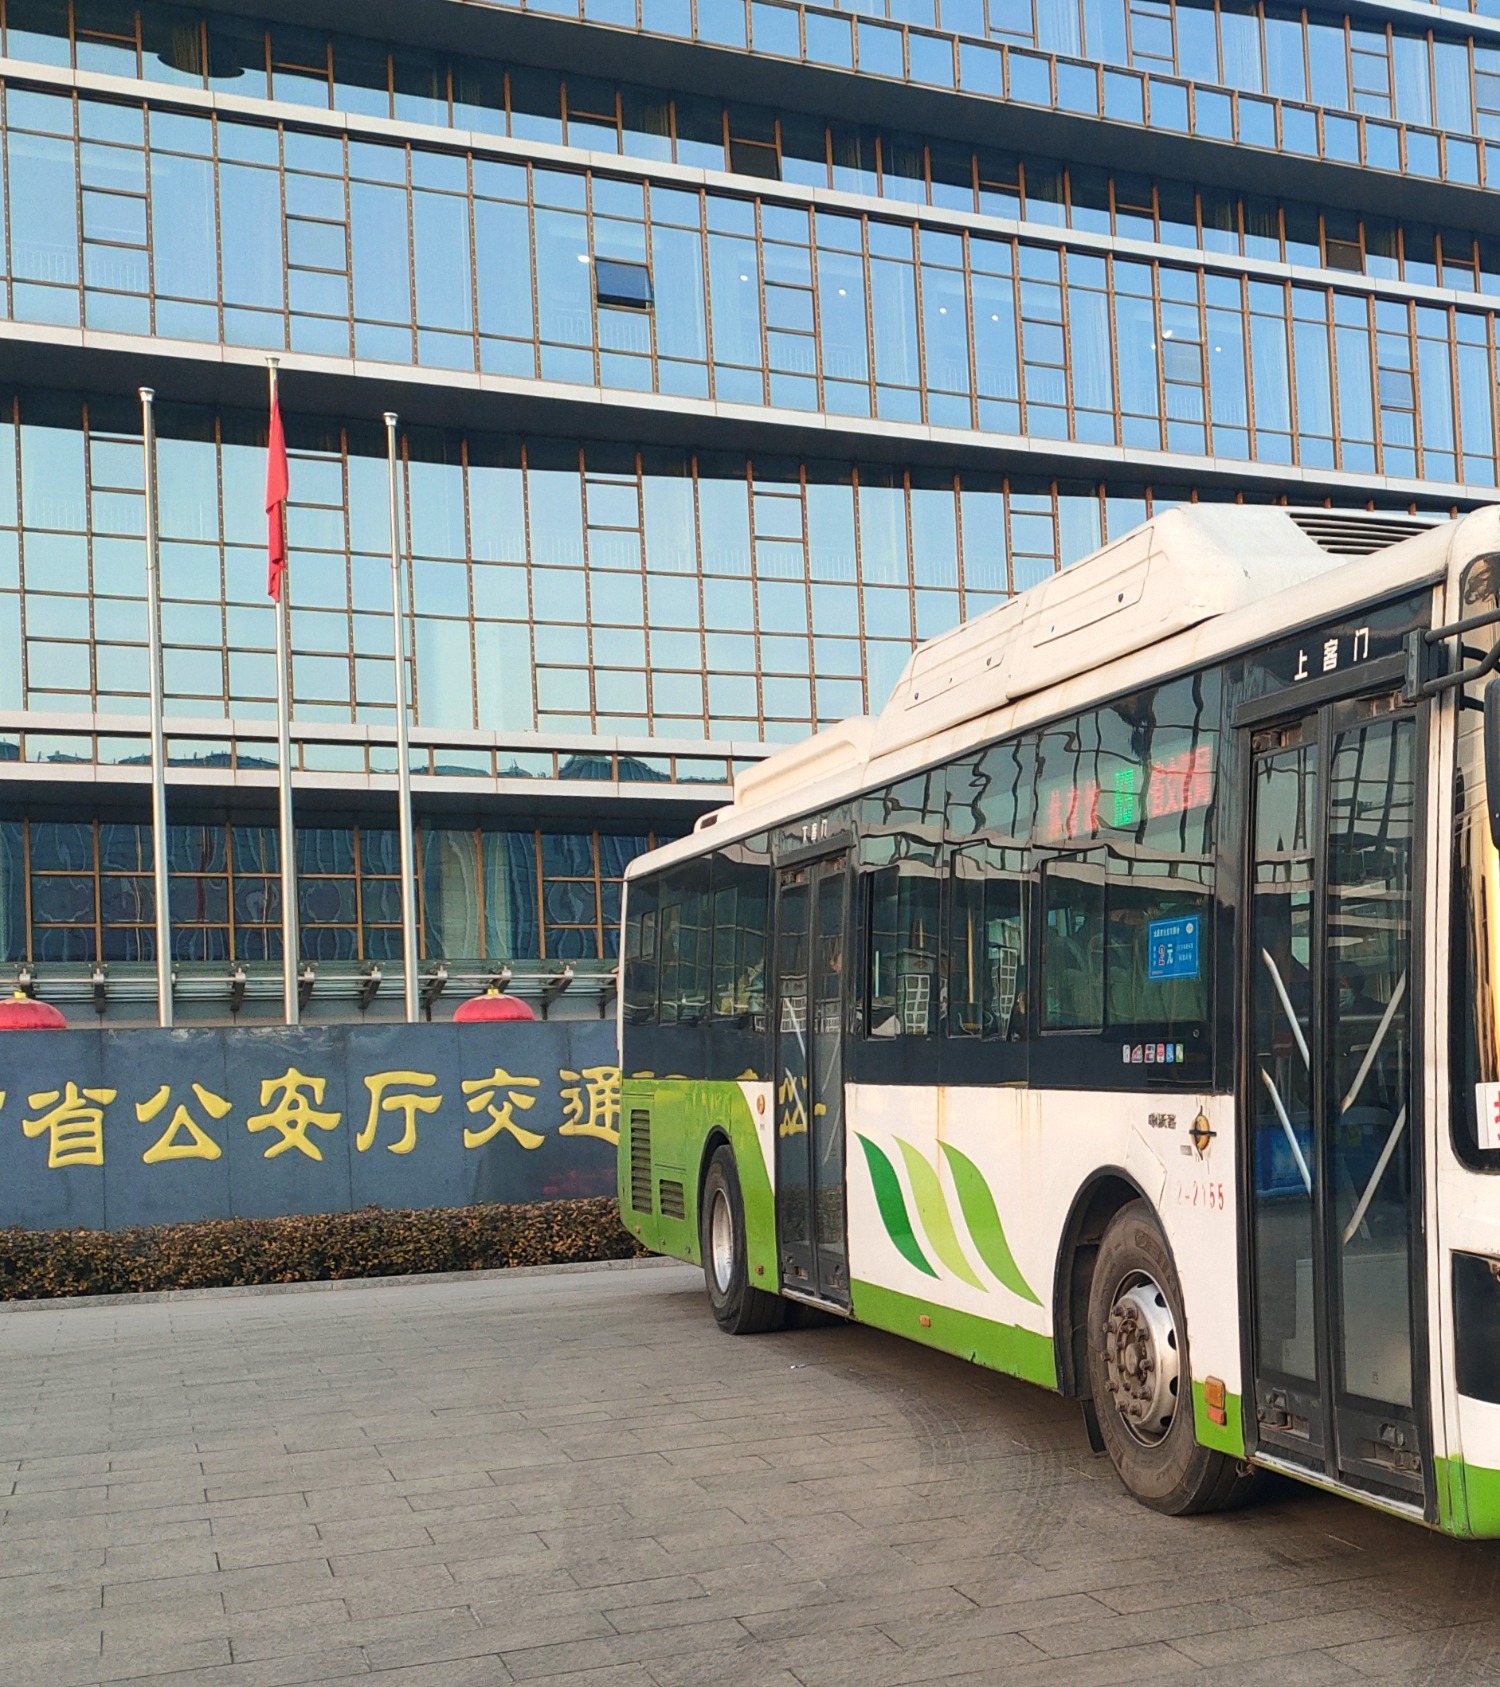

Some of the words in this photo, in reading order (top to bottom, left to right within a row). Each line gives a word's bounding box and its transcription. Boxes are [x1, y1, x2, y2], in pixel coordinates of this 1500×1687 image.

[1293, 626, 1370, 682] 上客门
[0, 1065, 621, 1169] 省公安厅交通
